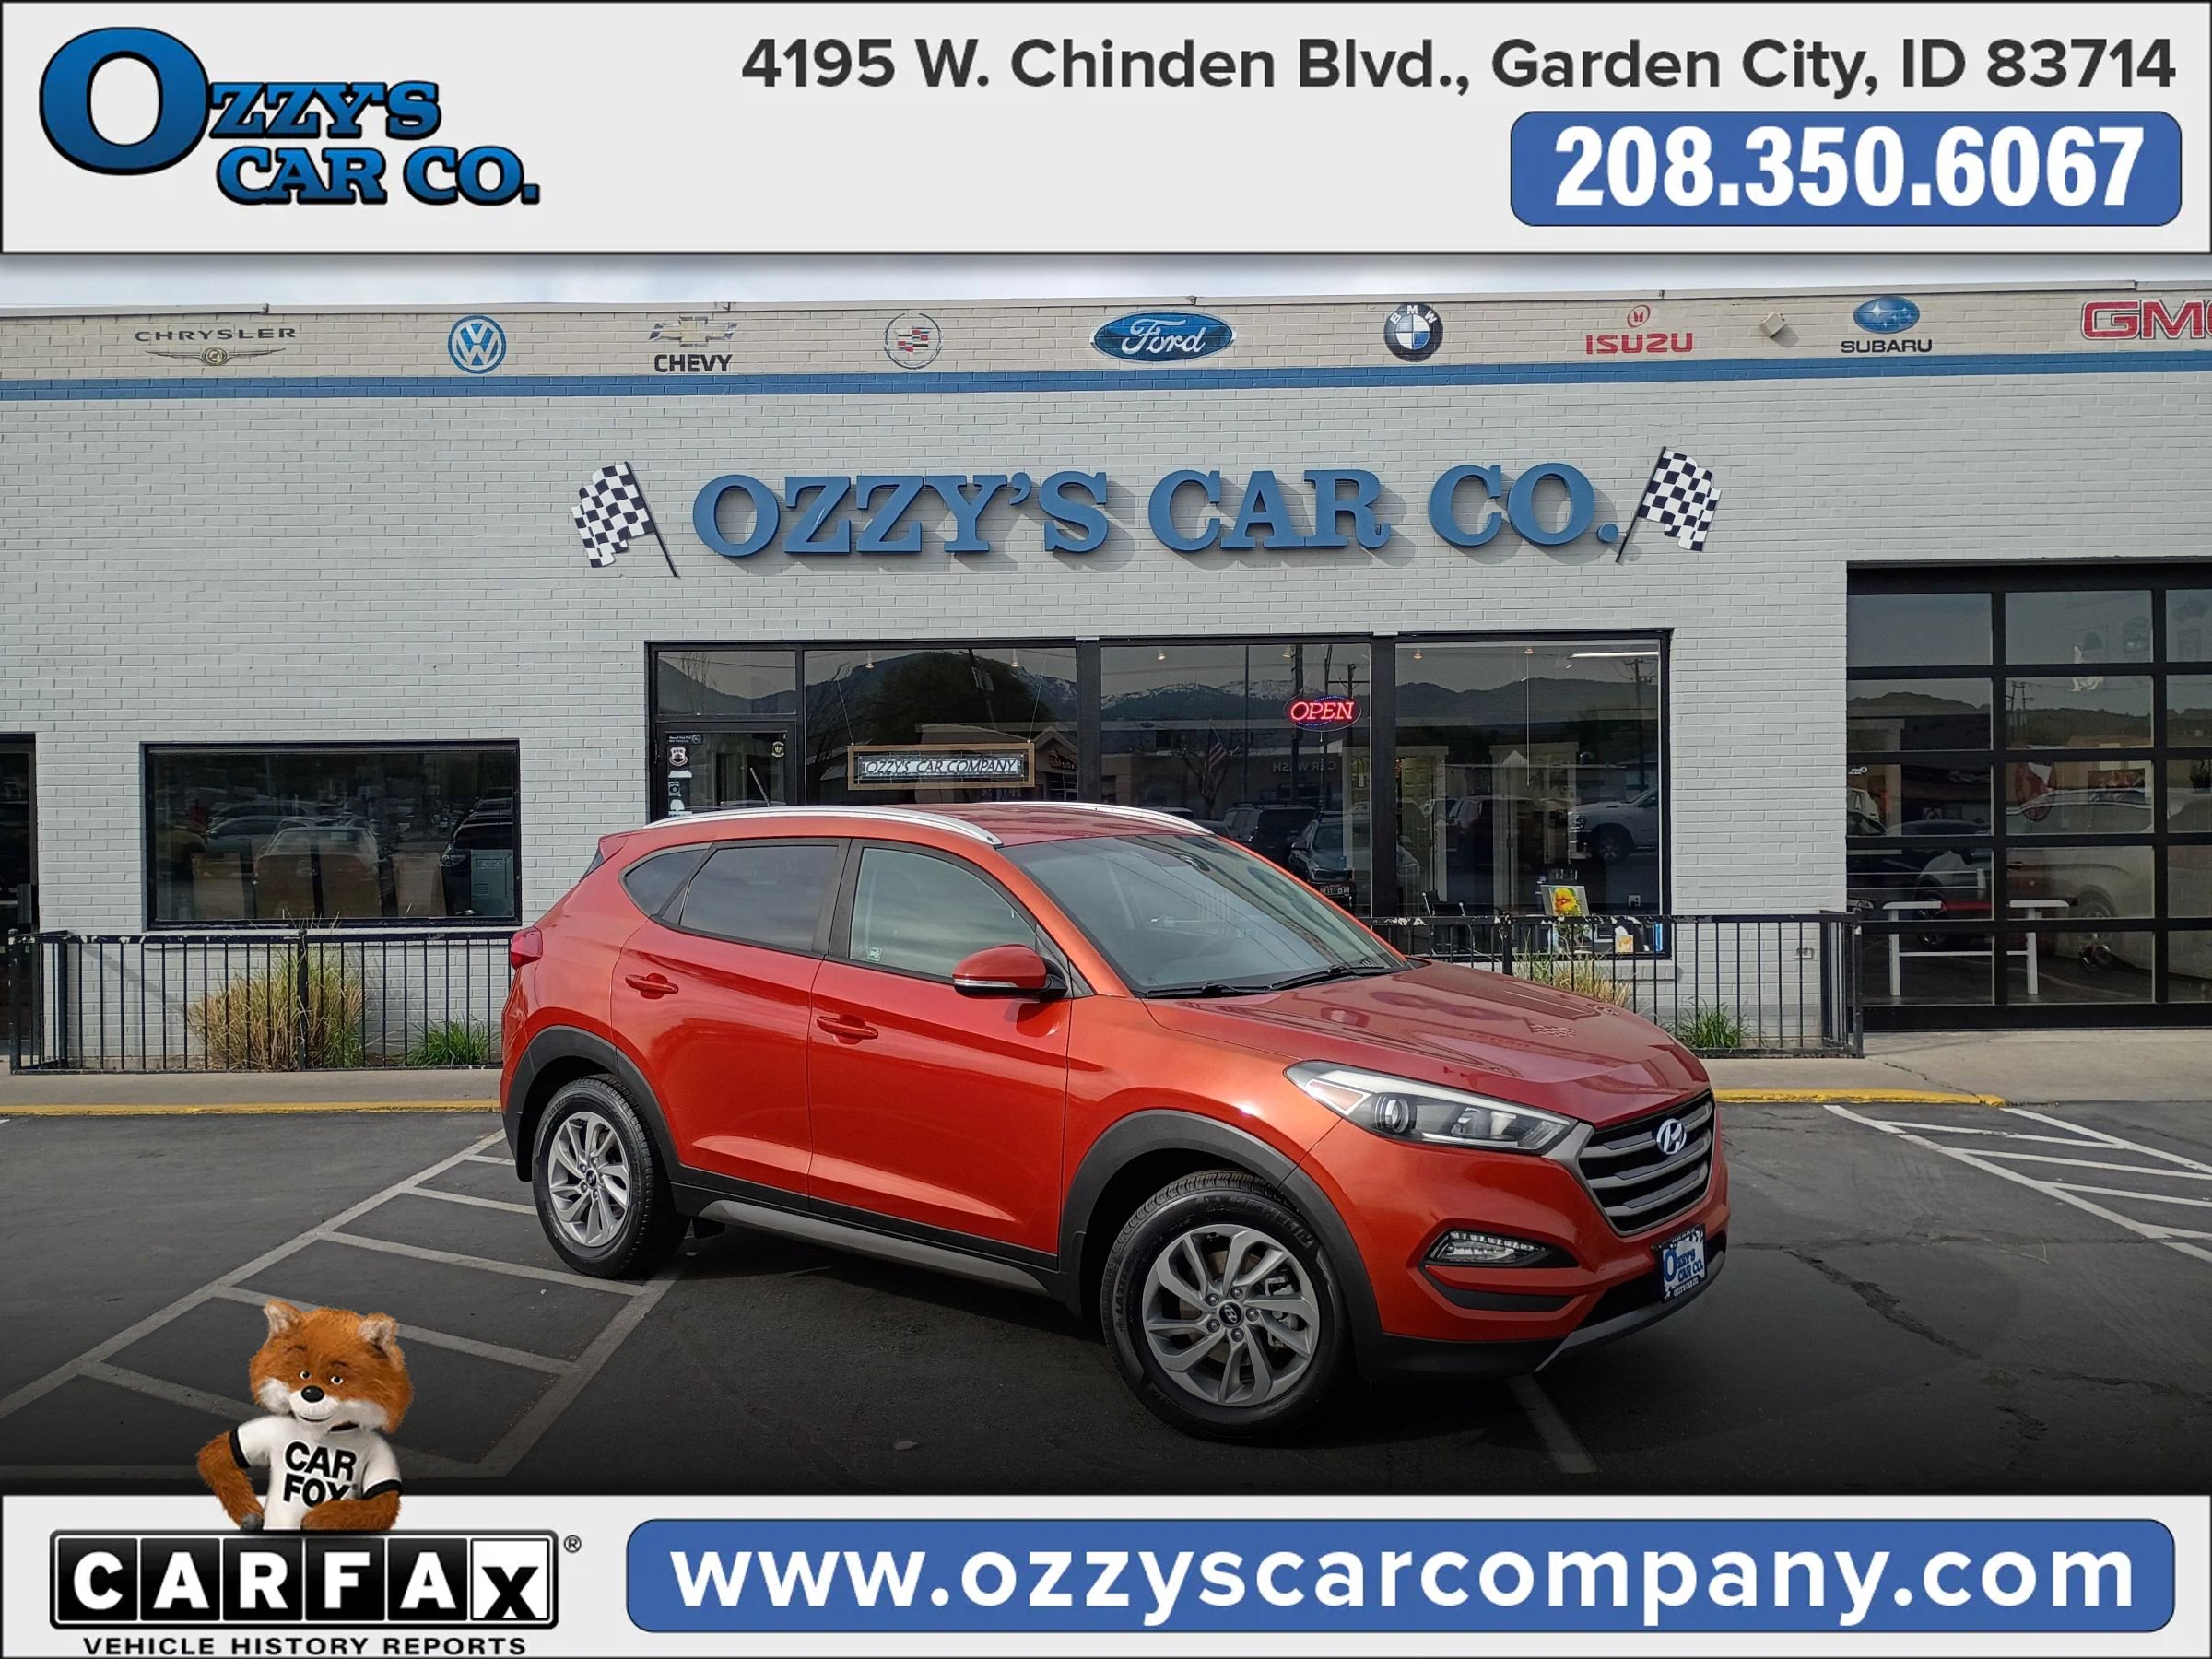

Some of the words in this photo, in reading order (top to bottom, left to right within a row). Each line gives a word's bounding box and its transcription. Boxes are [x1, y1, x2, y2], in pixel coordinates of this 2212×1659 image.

[1390, 304, 1438, 325] BMW
[2081, 300, 2212, 341] GM
[135, 328, 296, 342] CHRYSLER
[1121, 318, 1207, 355] Ford
[1585, 332, 1694, 355] ISUZU
[1841, 338, 1934, 354] SUBARU
[653, 353, 733, 373] CHEVY
[692, 470, 1109, 558] OZZY'S
[1148, 468, 1391, 552] CAR
[1428, 463, 1619, 547] CO.
[1290, 701, 1355, 721] OPEN
[865, 759, 910, 774] OZZY'S
[916, 759, 942, 773] CAR
[947, 759, 1016, 774] COMPANY
